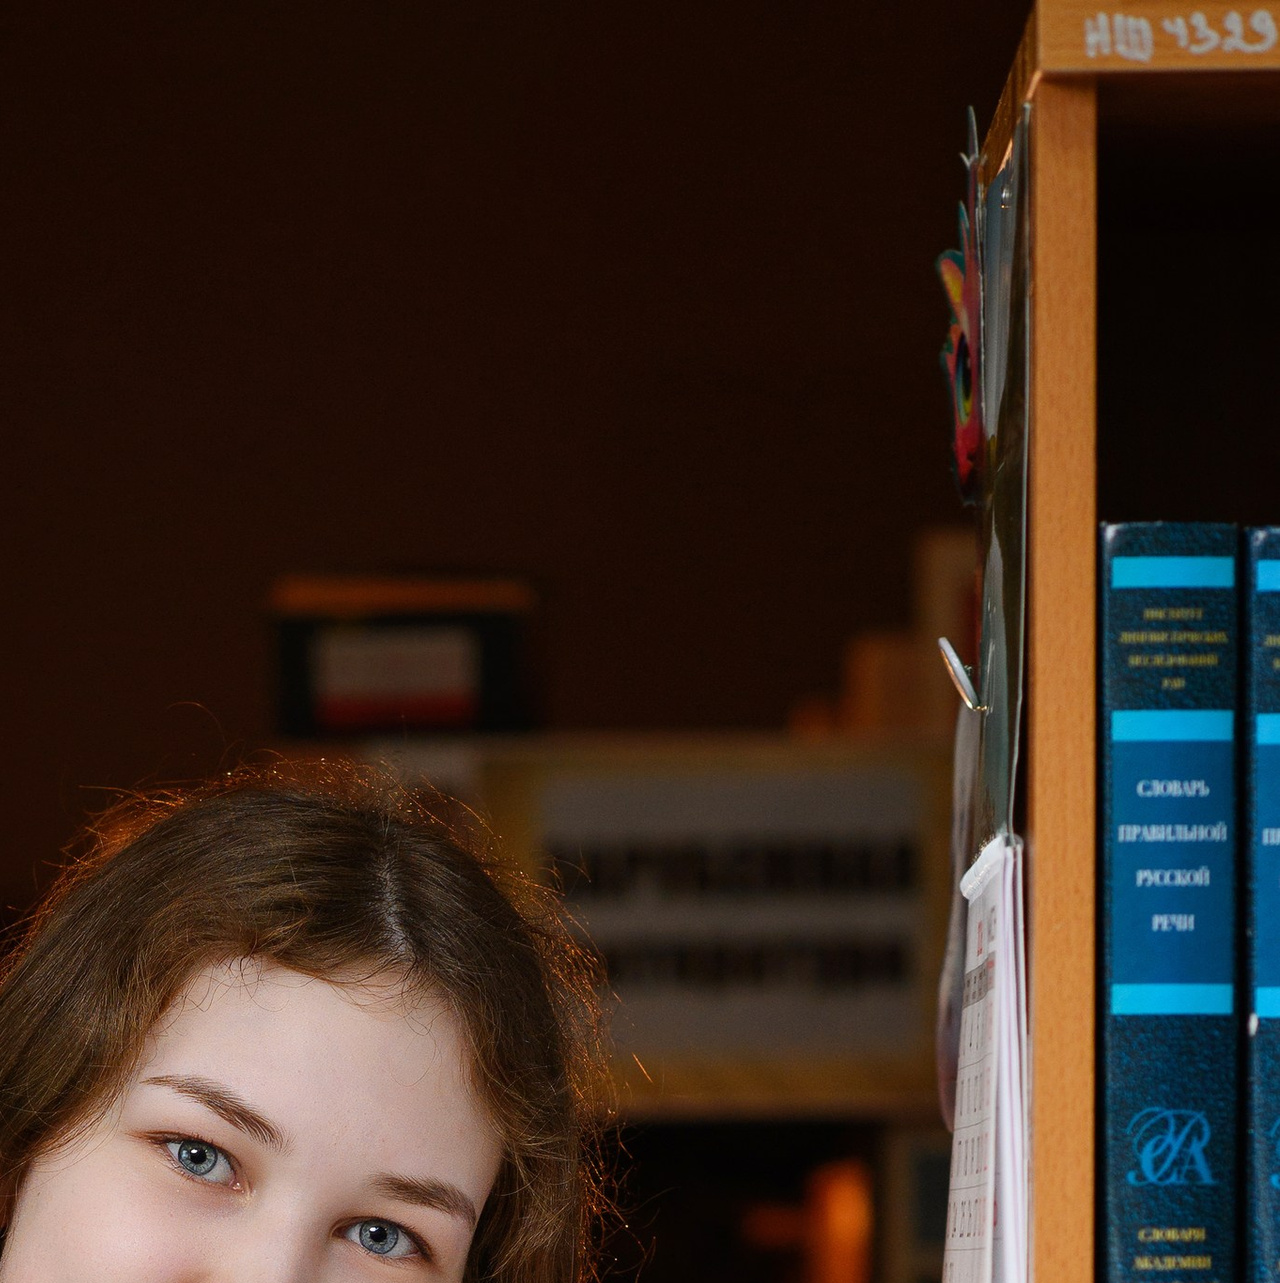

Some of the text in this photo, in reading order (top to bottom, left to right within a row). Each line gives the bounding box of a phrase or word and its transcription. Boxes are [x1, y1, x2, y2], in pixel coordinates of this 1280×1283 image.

[1136, 779, 1210, 797] СЛОВАРЬ
[1118, 821, 1227, 842] ПРАВИЛЬНОЙ
[1136, 866, 1210, 887] РУССКОЙ
[1152, 914, 1195, 932] РЕЧИ
[1138, 1227, 1205, 1242] СЛОВАРИ
[1133, 1256, 1211, 1270] АКАДЕМИИ
